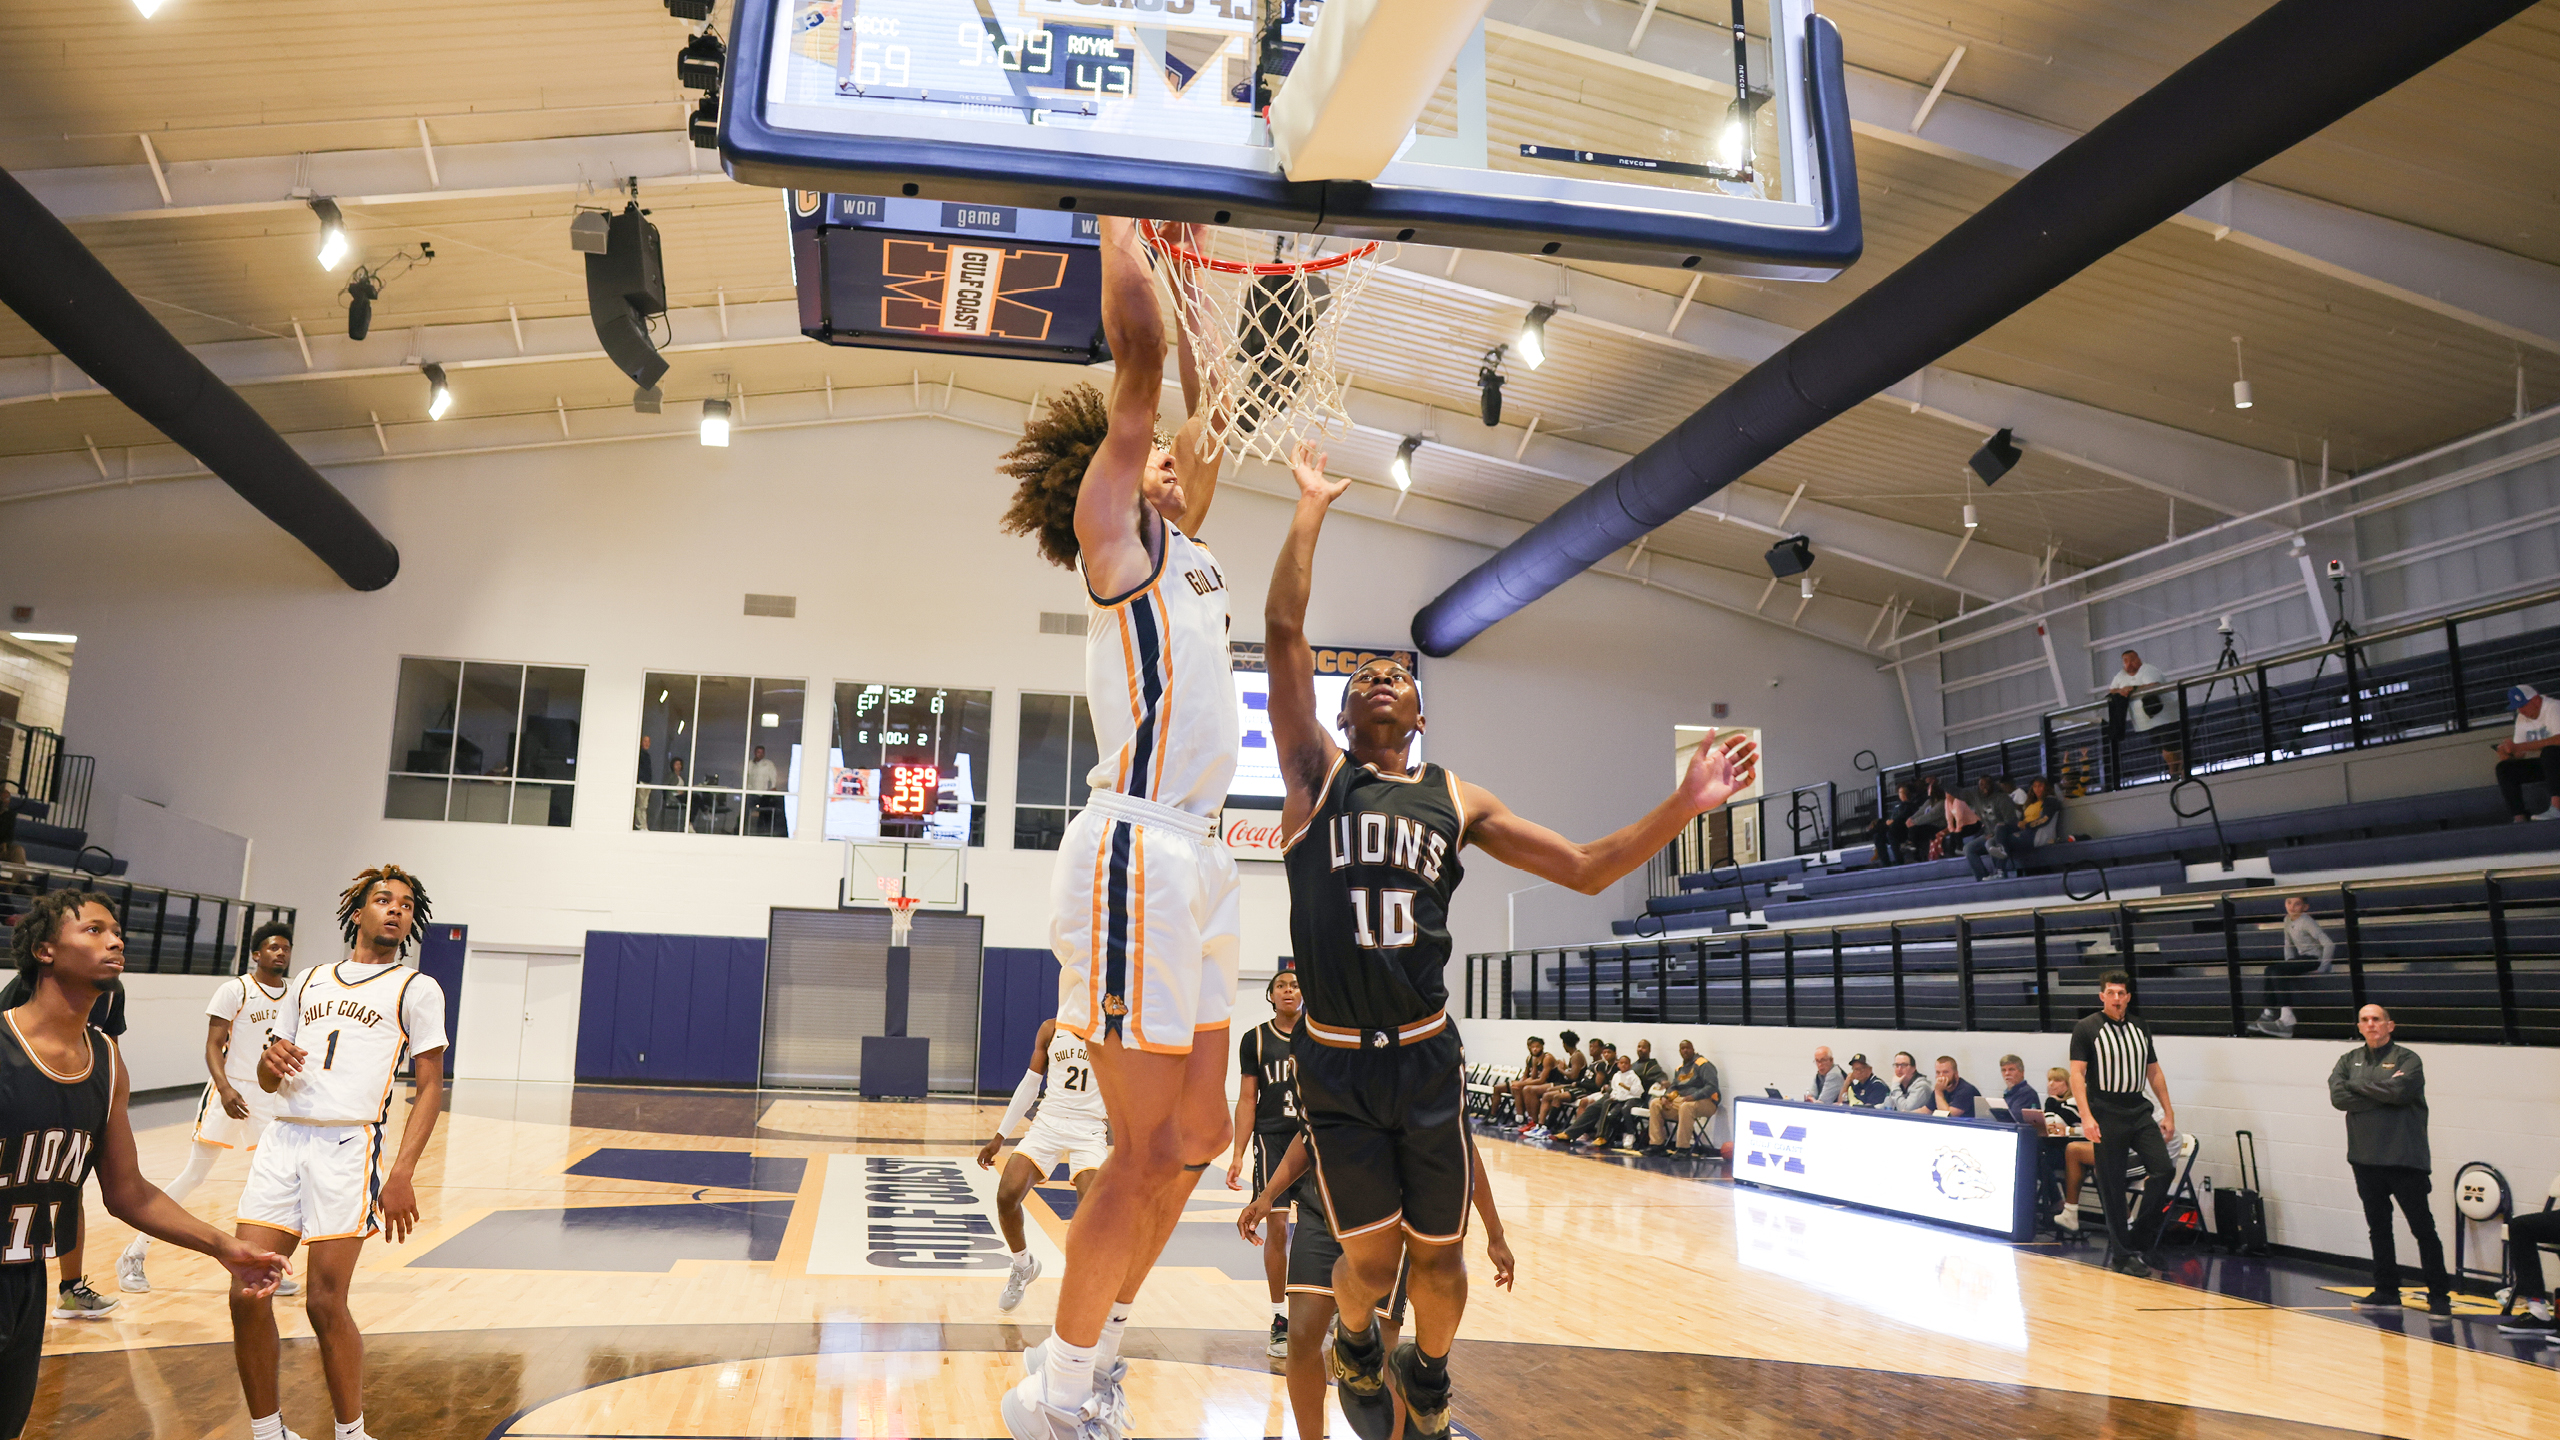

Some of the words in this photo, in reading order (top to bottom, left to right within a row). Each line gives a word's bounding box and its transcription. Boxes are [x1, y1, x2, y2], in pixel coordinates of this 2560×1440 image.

[958, 22, 1053, 74] 9:29
[1067, 35, 1119, 58] ROYAL
[854, 42, 911, 88] 69
[843, 198, 877, 216] won
[957, 207, 1001, 228] game
[959, 251, 989, 289] GULF
[953, 289, 983, 331] COAST
[894, 766, 937, 788] 9:29
[892, 786, 925, 812] 23
[1328, 811, 1448, 884] LIONS
[1349, 887, 1418, 950] 10
[250, 1009, 270, 1024] GULF
[304, 1000, 334, 1026] GULF
[337, 1000, 384, 1029] COAST
[322, 1029, 341, 1071] 1
[1054, 1048, 1075, 1062] GULF
[1064, 1065, 1089, 1092] 21
